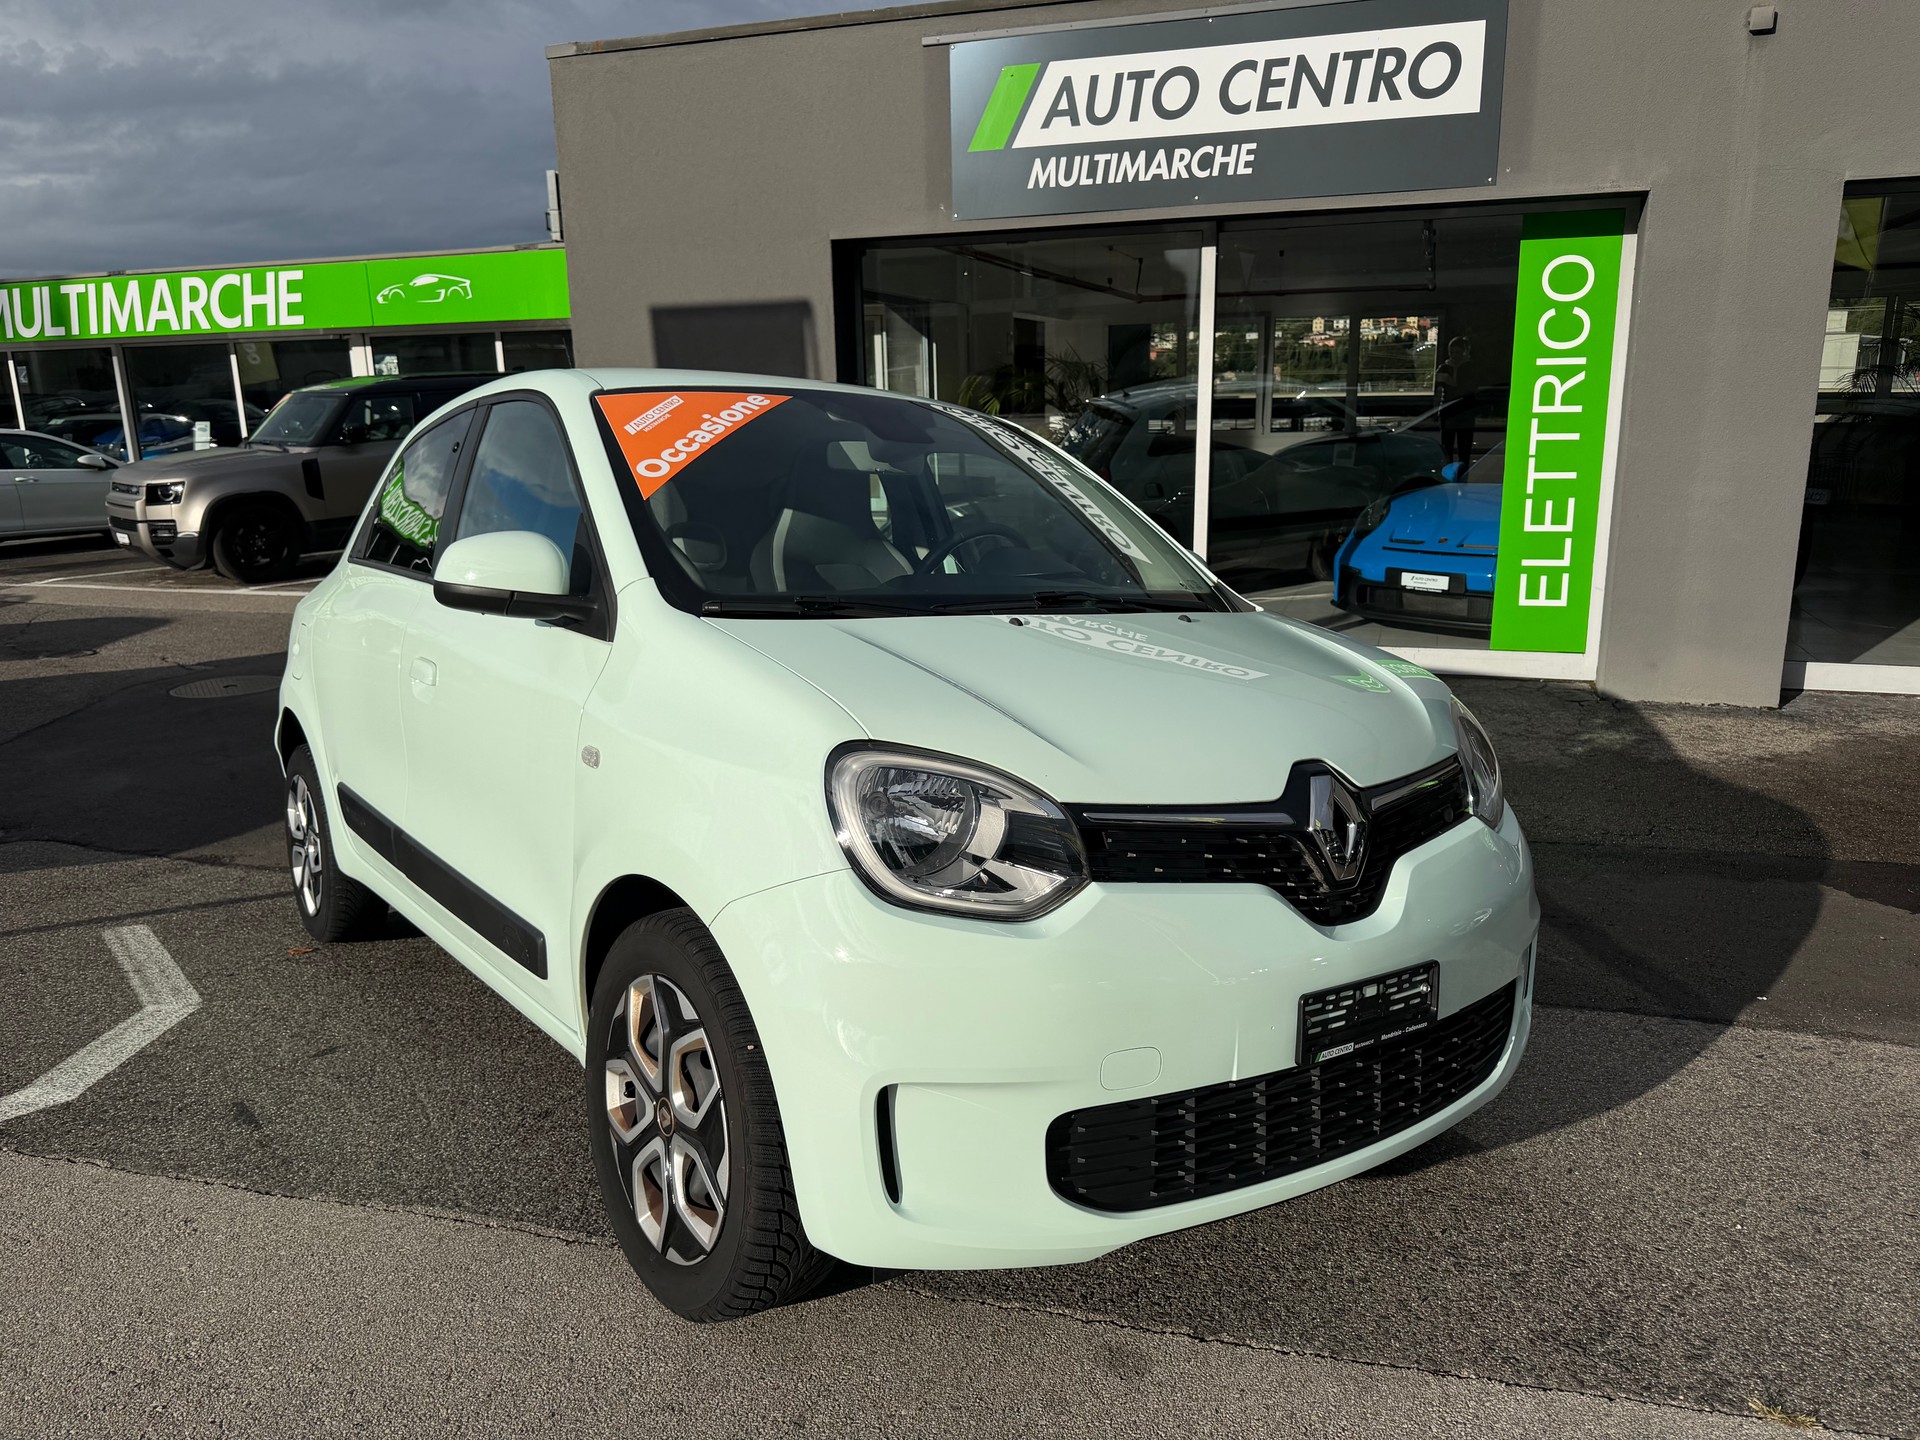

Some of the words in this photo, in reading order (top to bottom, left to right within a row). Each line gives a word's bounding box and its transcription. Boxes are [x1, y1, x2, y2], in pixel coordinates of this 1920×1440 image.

[1040, 65, 1200, 129] AUTO
[1218, 41, 1463, 115] CENTRO
[1026, 142, 1258, 190] MULTIMARCHE
[633, 411, 655, 429] AUTO
[652, 397, 681, 419] CENTRO
[636, 395, 771, 478] Occasione
[1518, 254, 1595, 607] ELETTRICO
